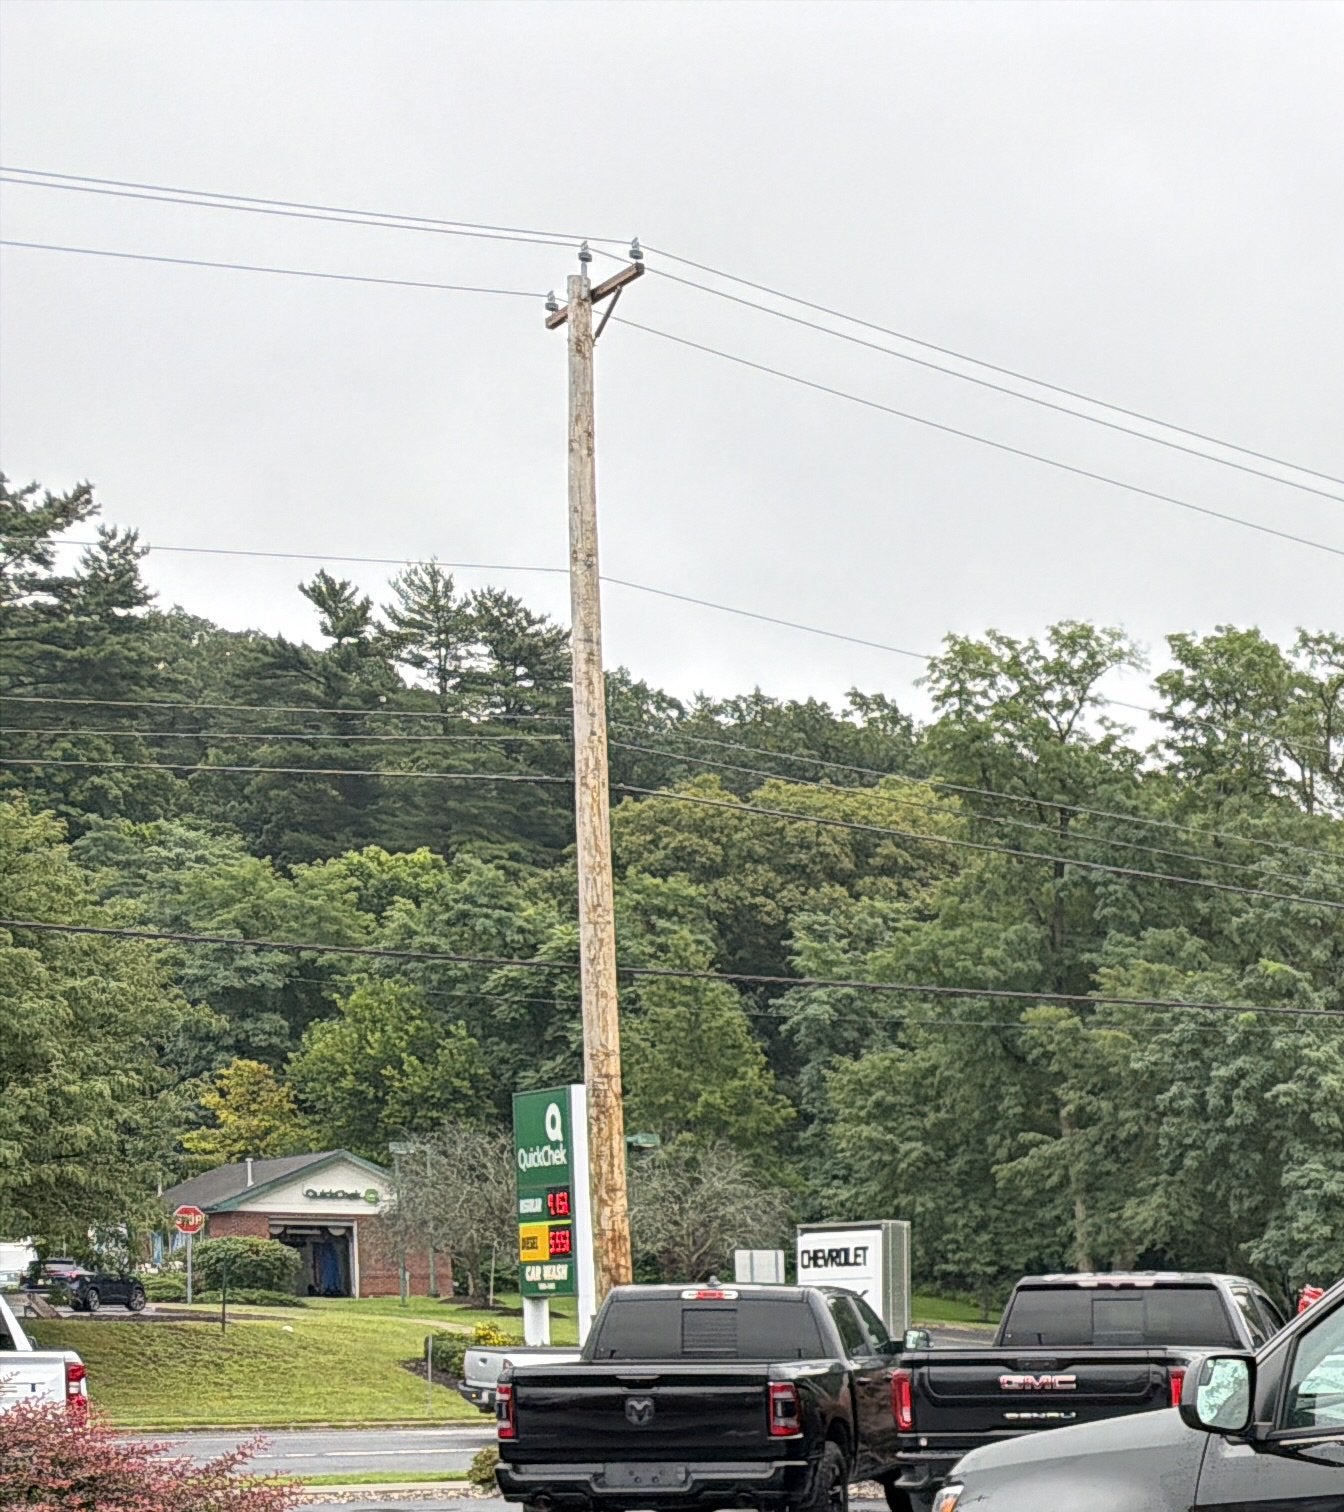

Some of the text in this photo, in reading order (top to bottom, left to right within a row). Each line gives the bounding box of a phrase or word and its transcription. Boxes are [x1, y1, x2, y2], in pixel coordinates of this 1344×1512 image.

[518, 1144, 566, 1171] QuickChek
[175, 1213, 202, 1227] STOP
[801, 1246, 868, 1269] CHEVROLET
[525, 1263, 568, 1281] CAR WASH
[998, 1374, 1077, 1390] GMC
